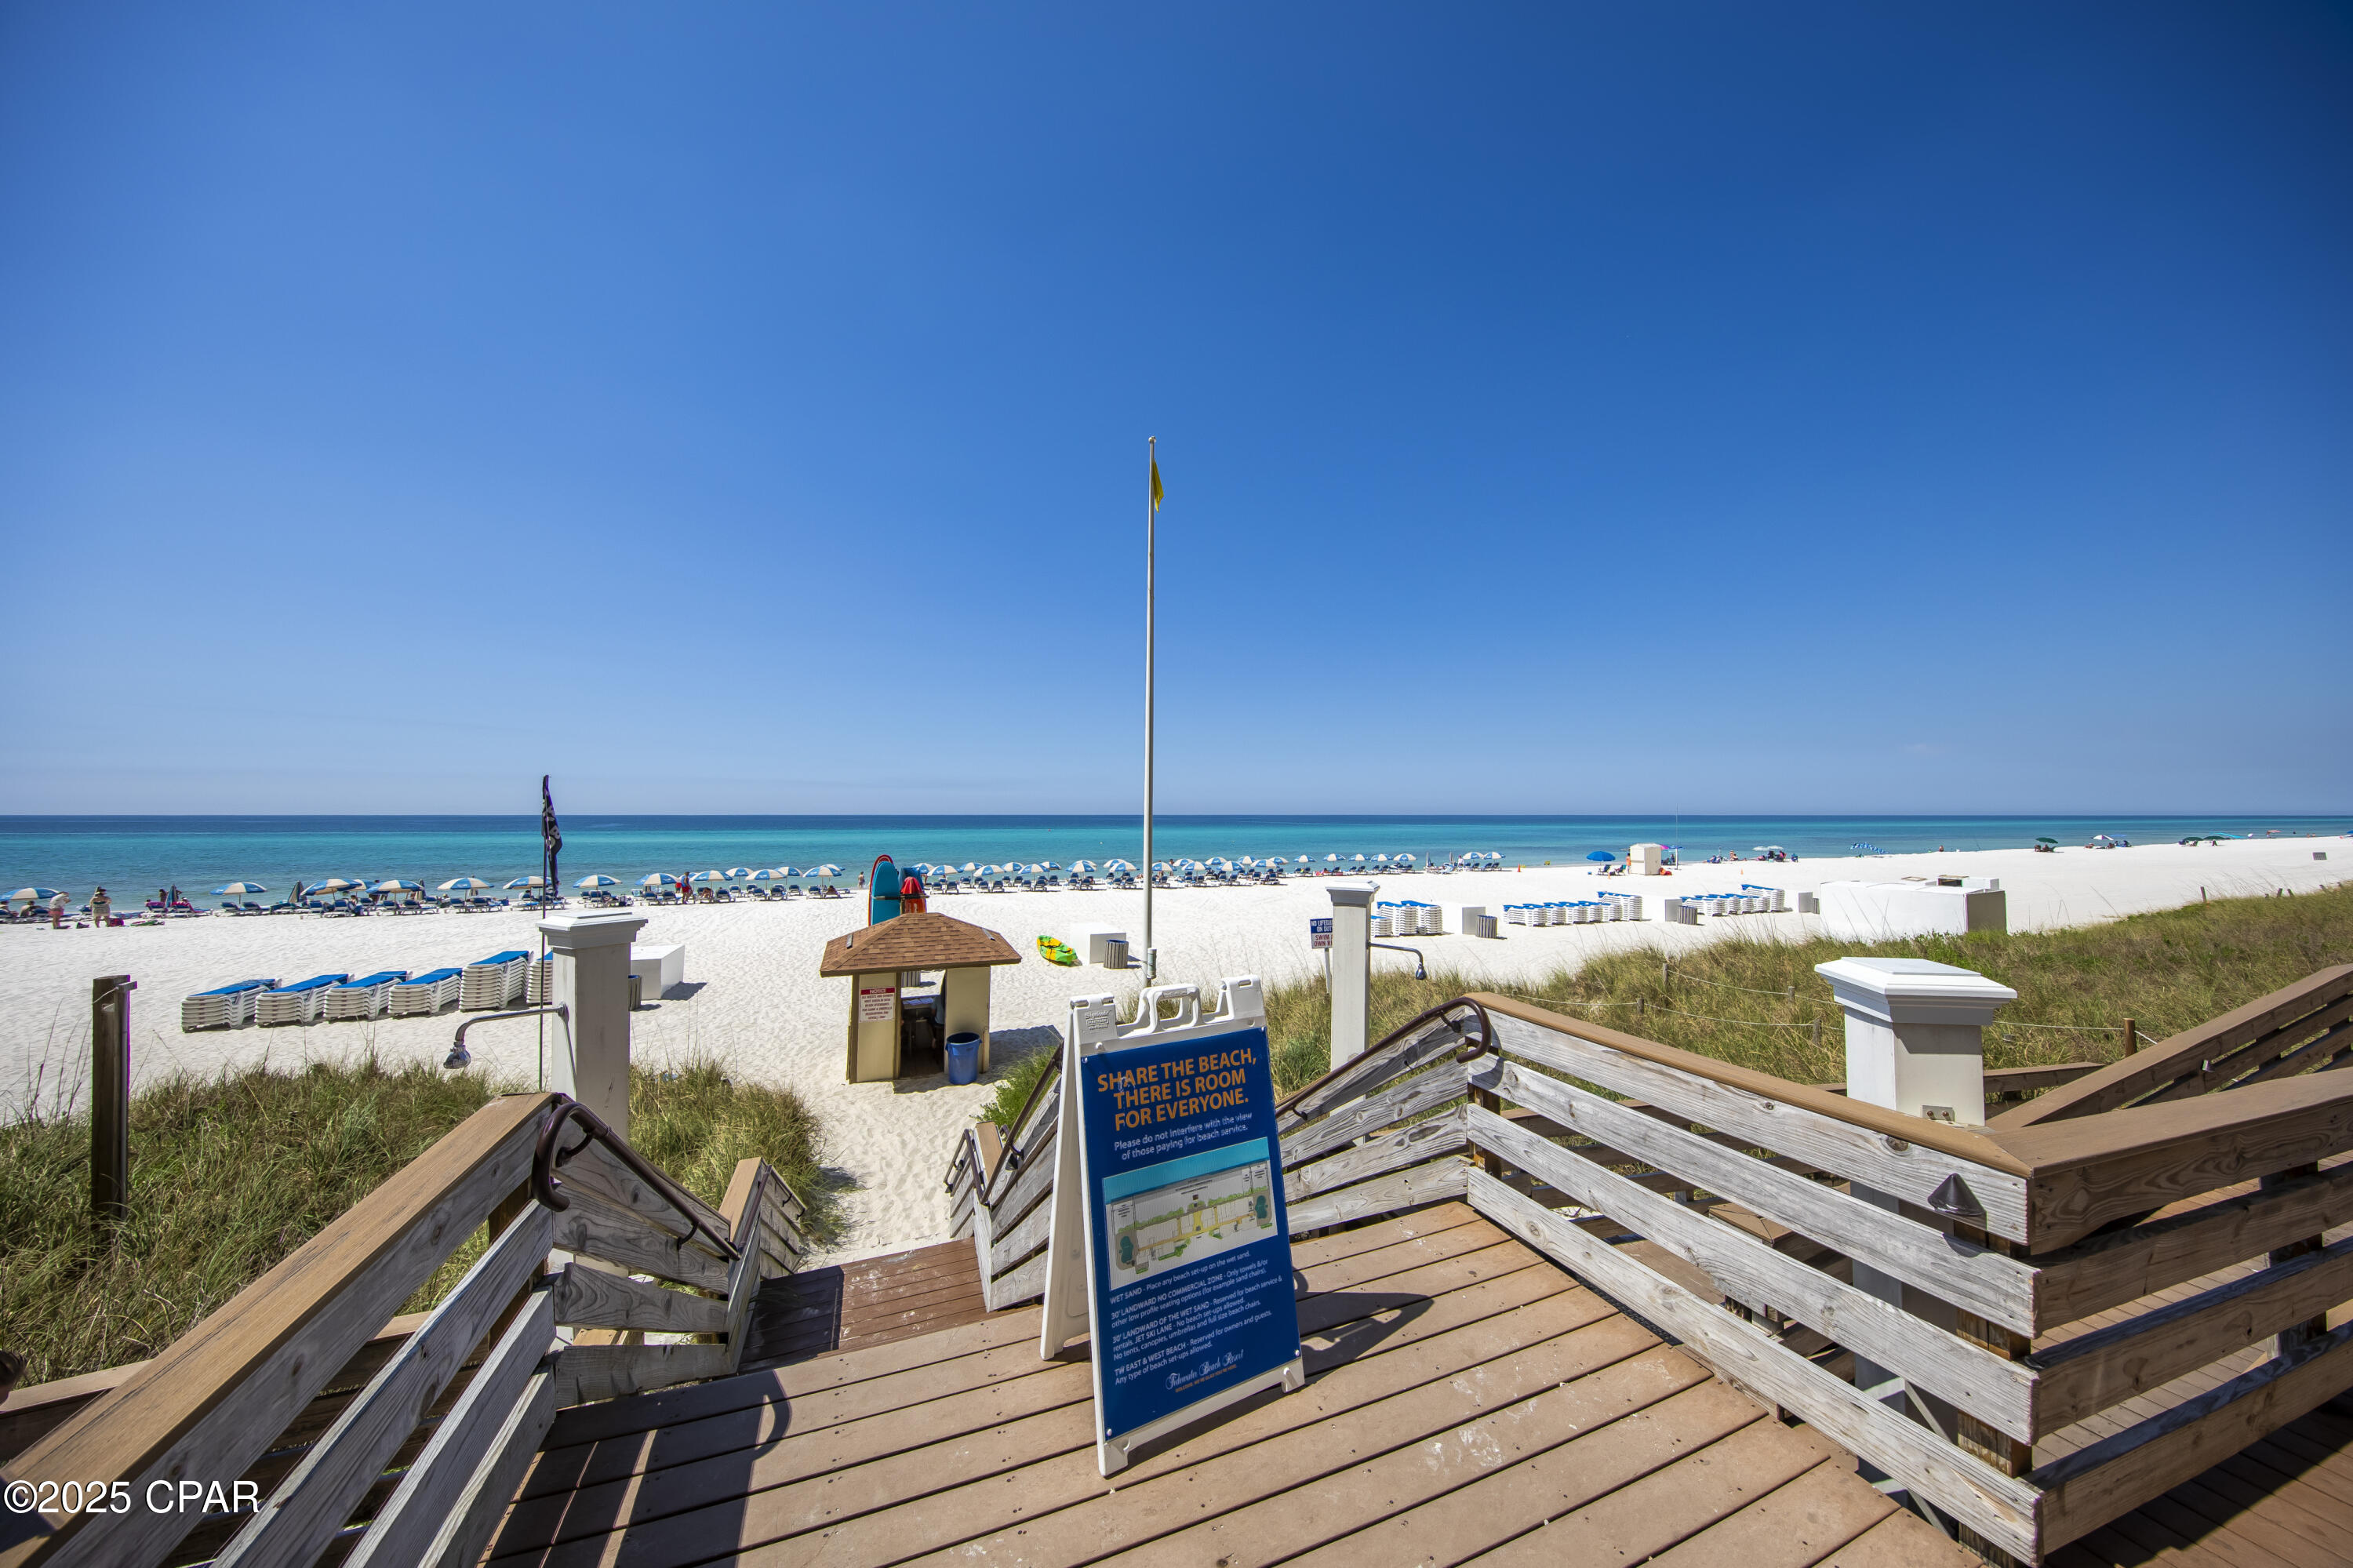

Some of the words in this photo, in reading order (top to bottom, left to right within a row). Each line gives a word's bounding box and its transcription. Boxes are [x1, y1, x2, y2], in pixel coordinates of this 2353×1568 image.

[1098, 1065, 1158, 1092] SHARE
[1161, 1059, 1195, 1079] THE
[1199, 1048, 1257, 1073] BEACH,
[1114, 1083, 1172, 1110] THERE
[1176, 1079, 1191, 1097] IS
[1195, 1068, 1246, 1093] ROOM
[1115, 1108, 1152, 1131] FOR
[1156, 1088, 1249, 1122] EVERYONE.
[1115, 1139, 1140, 1151] Please
[1143, 1135, 1153, 1144] do
[1155, 1131, 1169, 1142] not
[1169, 1123, 1203, 1138] interfere
[1204, 1118, 1220, 1130] with
[1222, 1115, 1234, 1126] the
[1235, 1112, 1253, 1122] view
[1122, 1151, 1131, 1161] of
[1132, 1146, 1155, 1159] those
[1157, 1138, 1184, 1155] paying
[1184, 1136, 1195, 1145] for
[1197, 1130, 1220, 1142] beach
[1221, 1124, 1248, 1137] service.
[1110, 1293, 1124, 1304] WET
[1125, 1288, 1142, 1300] SAND
[1146, 1282, 1162, 1291] Place
[1173, 1271, 1190, 1282] beach
[1191, 1266, 1208, 1275] set-up
[1111, 1319, 1128, 1328] other
[1140, 1305, 1159, 1319] profile
[1160, 1299, 1180, 1310] seating
[1181, 1291, 1202, 1303] options
[1213, 1279, 1235, 1291] example
[1121, 1297, 1156, 1316] LANDWARD
[1168, 1280, 1206, 1298] COMMERCIAL
[1208, 1274, 1223, 1285] ZONE
[1227, 1269, 1239, 1278] Only
[1240, 1264, 1257, 1273] towels
[1113, 1341, 1134, 1352] rentals.
[1135, 1334, 1145, 1344] JET
[1146, 1330, 1155, 1339] SKI
[1156, 1323, 1173, 1334] LANE
[1186, 1313, 1202, 1324] beach
[1203, 1307, 1223, 1318] set-ups
[1224, 1297, 1245, 1310] allowed.
[1123, 1320, 1158, 1340] LANDWARD
[1168, 1312, 1180, 1322] THE
[1180, 1308, 1193, 1317] WET
[1193, 1301, 1210, 1313] SAND
[1213, 1293, 1237, 1306] Reserved
[1245, 1283, 1260, 1293] beach
[1261, 1278, 1278, 1288] service
[1124, 1348, 1140, 1357] tents,
[1141, 1336, 1168, 1350] canopies,
[1169, 1324, 1196, 1339] umbrellas
[1197, 1319, 1207, 1329] and
[1208, 1315, 1217, 1324] full
[1229, 1306, 1244, 1315] beach
[1245, 1301, 1261, 1310] chairs.
[1115, 1366, 1125, 1377] TW
[1126, 1359, 1141, 1372] EAST
[1148, 1351, 1165, 1362] WEST
[1166, 1343, 1186, 1355] BEACH
[1190, 1331, 1215, 1346] Reserved
[1224, 1322, 1243, 1333] owners
[1244, 1315, 1254, 1325] and
[1255, 1311, 1272, 1322] guests.
[1115, 1376, 1127, 1385] Any
[1128, 1370, 1142, 1381] type
[1150, 1359, 1167, 1371] beach
[1169, 1352, 1189, 1363] set-ups
[1190, 1341, 1213, 1355] allowed.
[1199, 1357, 1221, 1376] Beach
